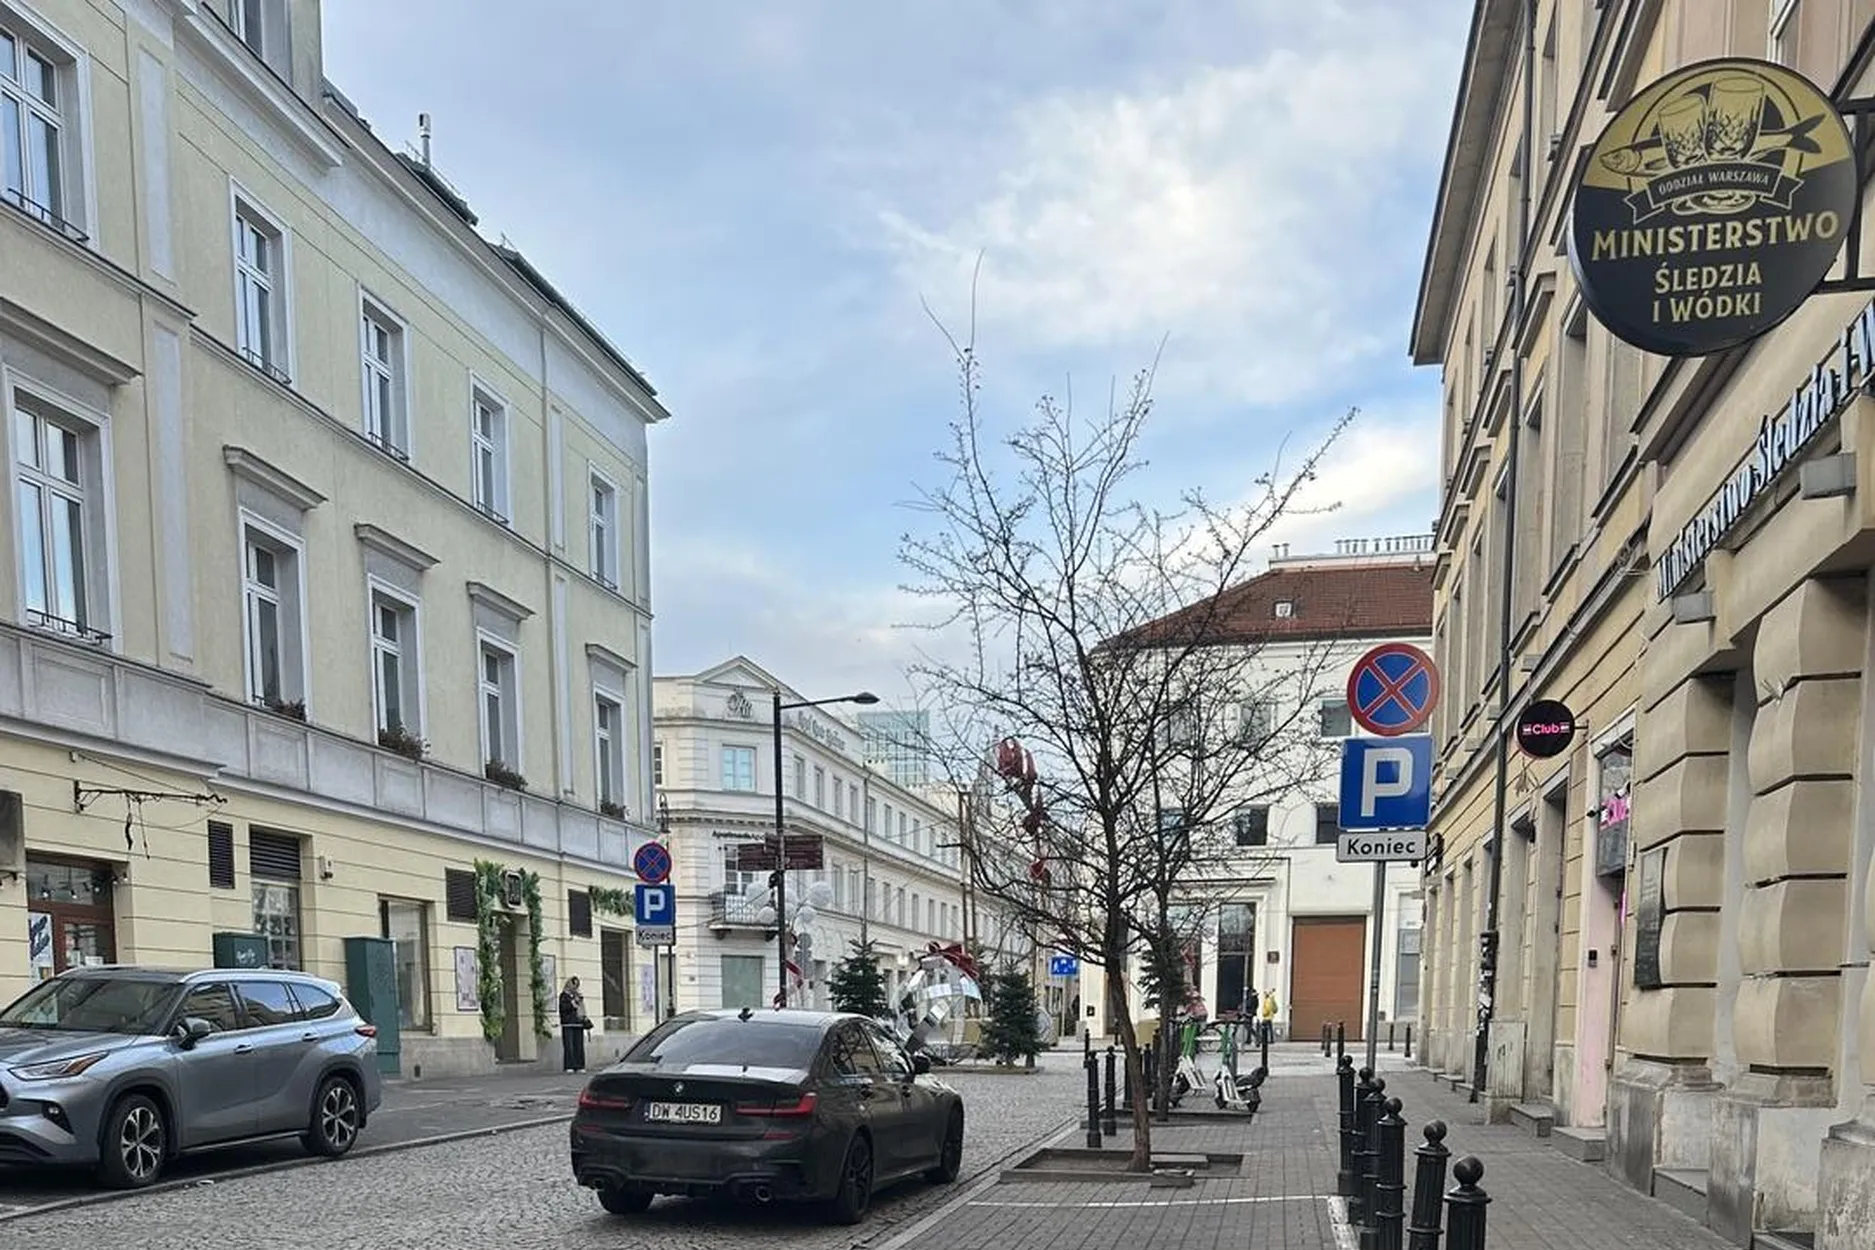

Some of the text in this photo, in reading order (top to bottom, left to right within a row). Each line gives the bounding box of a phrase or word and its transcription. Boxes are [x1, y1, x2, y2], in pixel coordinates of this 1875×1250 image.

[1708, 171, 1769, 186] WARSZAWA
[1591, 209, 1840, 262] MINISTERSTWO
[1654, 261, 1763, 294] ŚLEDZIA
[1652, 292, 1762, 323] I WÓDKI
[1532, 722, 1560, 735] Club
[1361, 747, 1413, 817] P
[1347, 838, 1416, 856] Koniec
[644, 889, 666, 920] P
[638, 929, 673, 941] Koniec
